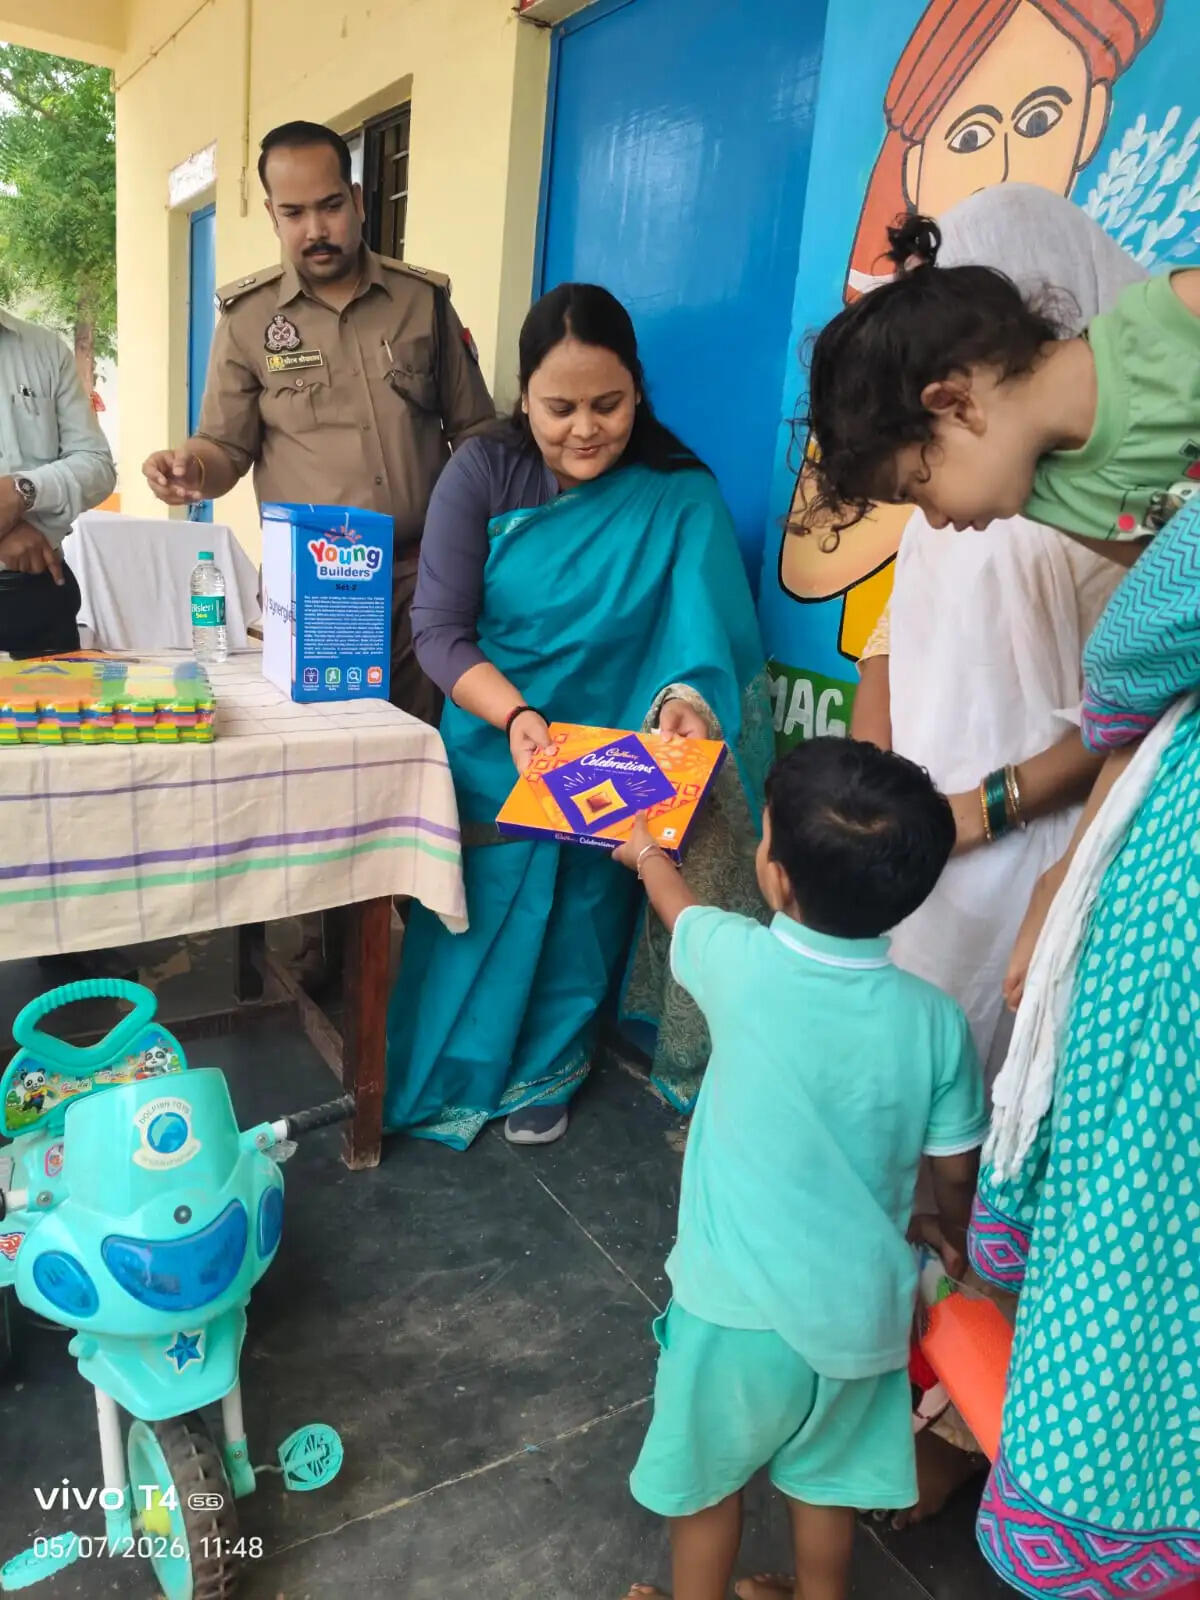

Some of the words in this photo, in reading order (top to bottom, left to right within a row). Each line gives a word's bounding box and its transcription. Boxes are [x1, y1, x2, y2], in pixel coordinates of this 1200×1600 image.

[310, 540, 381, 569] Young
[320, 566, 370, 578] Builders
[580, 753, 657, 775] Celebrations
[579, 836, 616, 849] Celebrations
